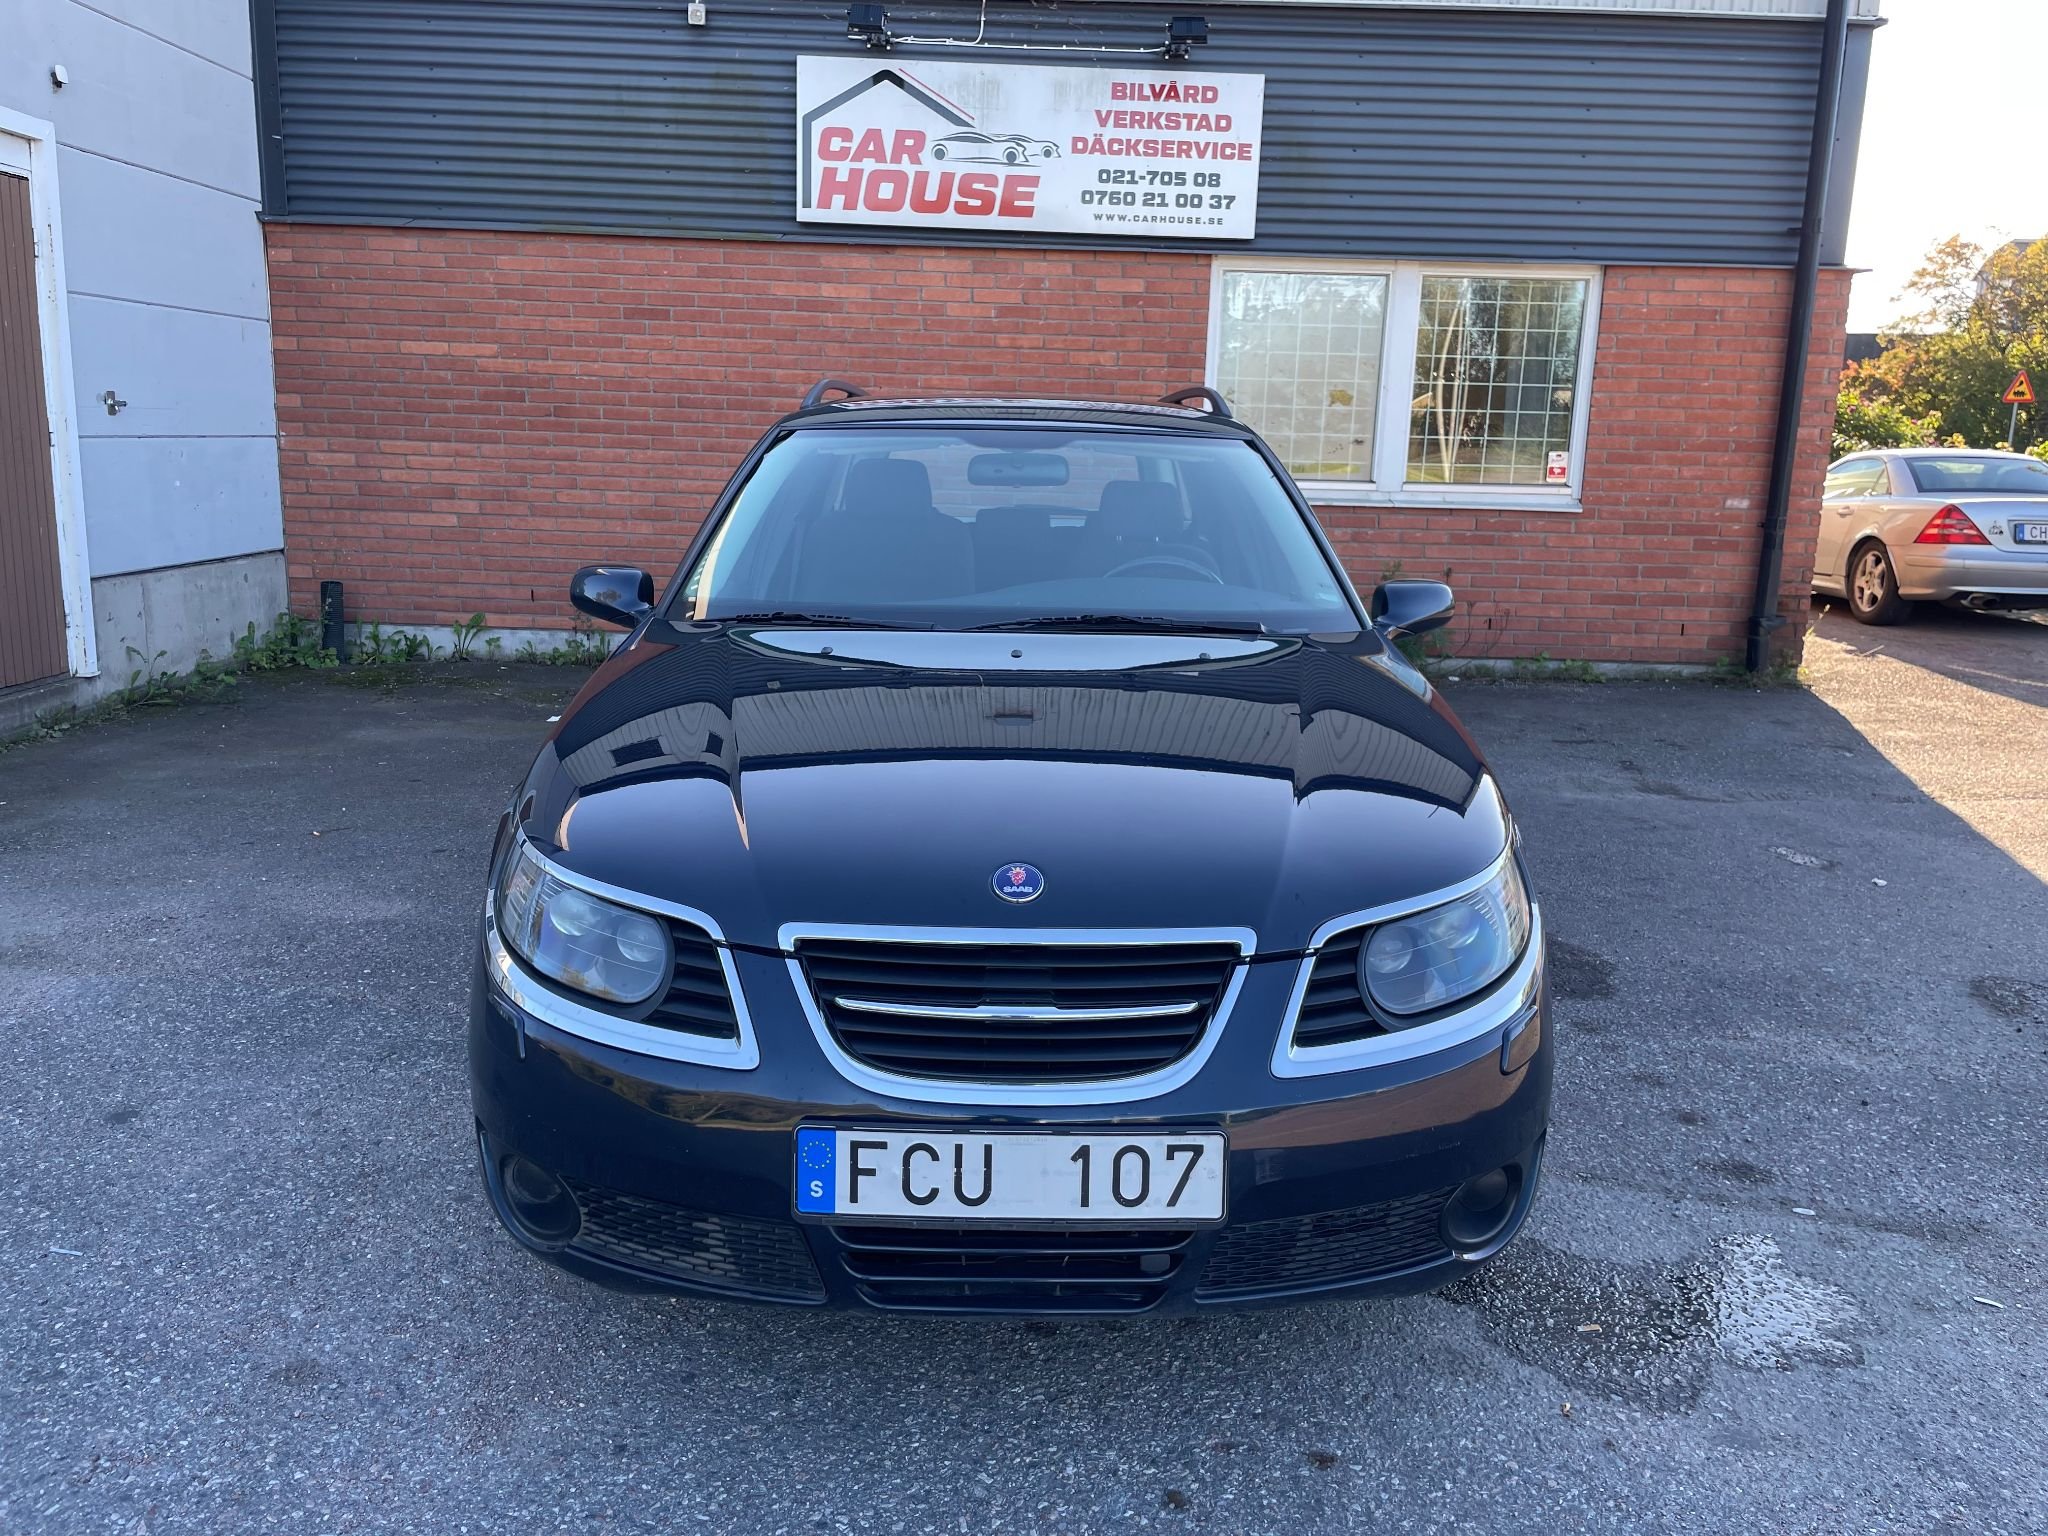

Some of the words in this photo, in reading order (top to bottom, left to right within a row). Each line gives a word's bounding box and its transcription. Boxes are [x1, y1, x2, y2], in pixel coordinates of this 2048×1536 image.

[1111, 81, 1219, 103] BILVÅRD
[1095, 110, 1232, 132] VERKSTAD
[817, 127, 926, 165] CAR
[1072, 133, 1252, 160] DÄCKSERVICE
[1098, 169, 1187, 187] 021-705
[1193, 172, 1221, 188] 08
[816, 167, 1041, 218] HOUSE
[1081, 190, 1136, 207] 0760
[1142, 192, 1169, 208] 21
[1175, 193, 1203, 209] 00
[1209, 194, 1236, 210] 37
[1093, 213, 1224, 226] WWW.CARHOUSE.SE
[849, 1140, 992, 1207] FCU
[1070, 1144, 1204, 1208] 107
[809, 1180, 824, 1198] S
